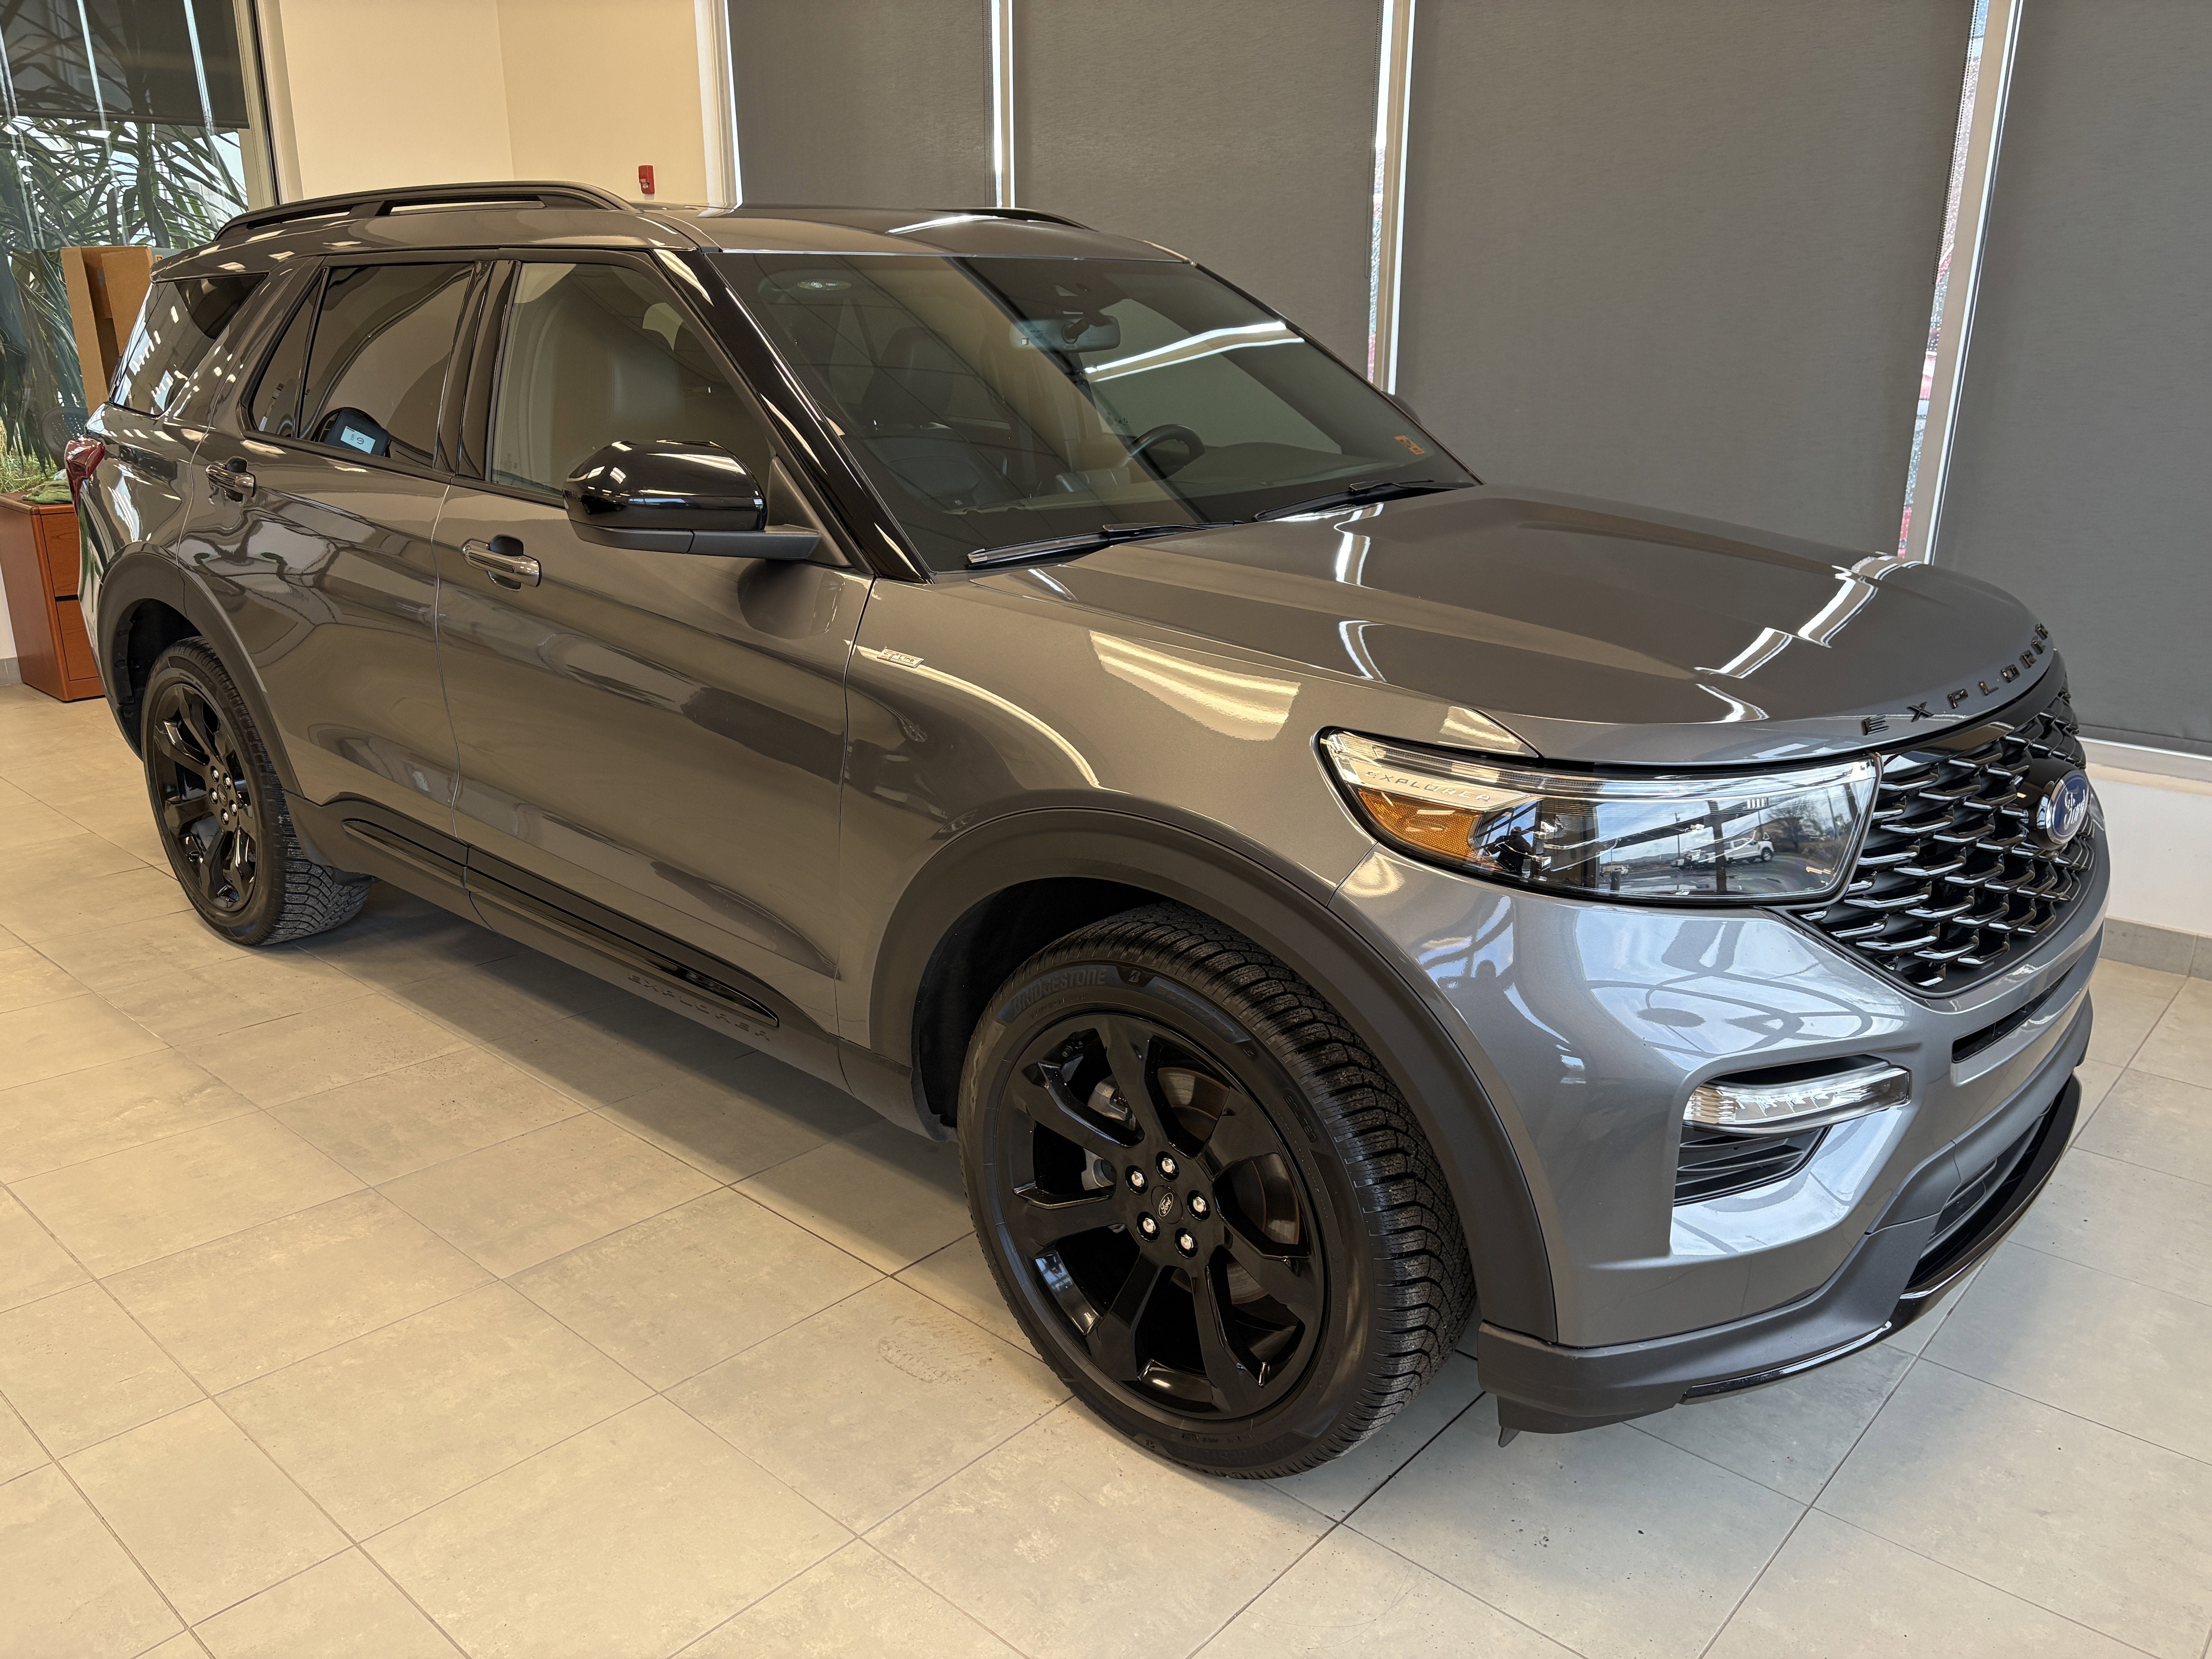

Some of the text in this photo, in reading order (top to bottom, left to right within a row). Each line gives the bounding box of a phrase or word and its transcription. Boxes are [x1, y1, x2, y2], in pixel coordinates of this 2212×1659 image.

[1862, 622, 2049, 735] EXPLORER
[1365, 770, 1491, 802] EXPLORER
[628, 974, 771, 1041] EXPLORER
[1012, 968, 1107, 1016] BRIDGESTONE
[1160, 1196, 1172, 1214] Ford
